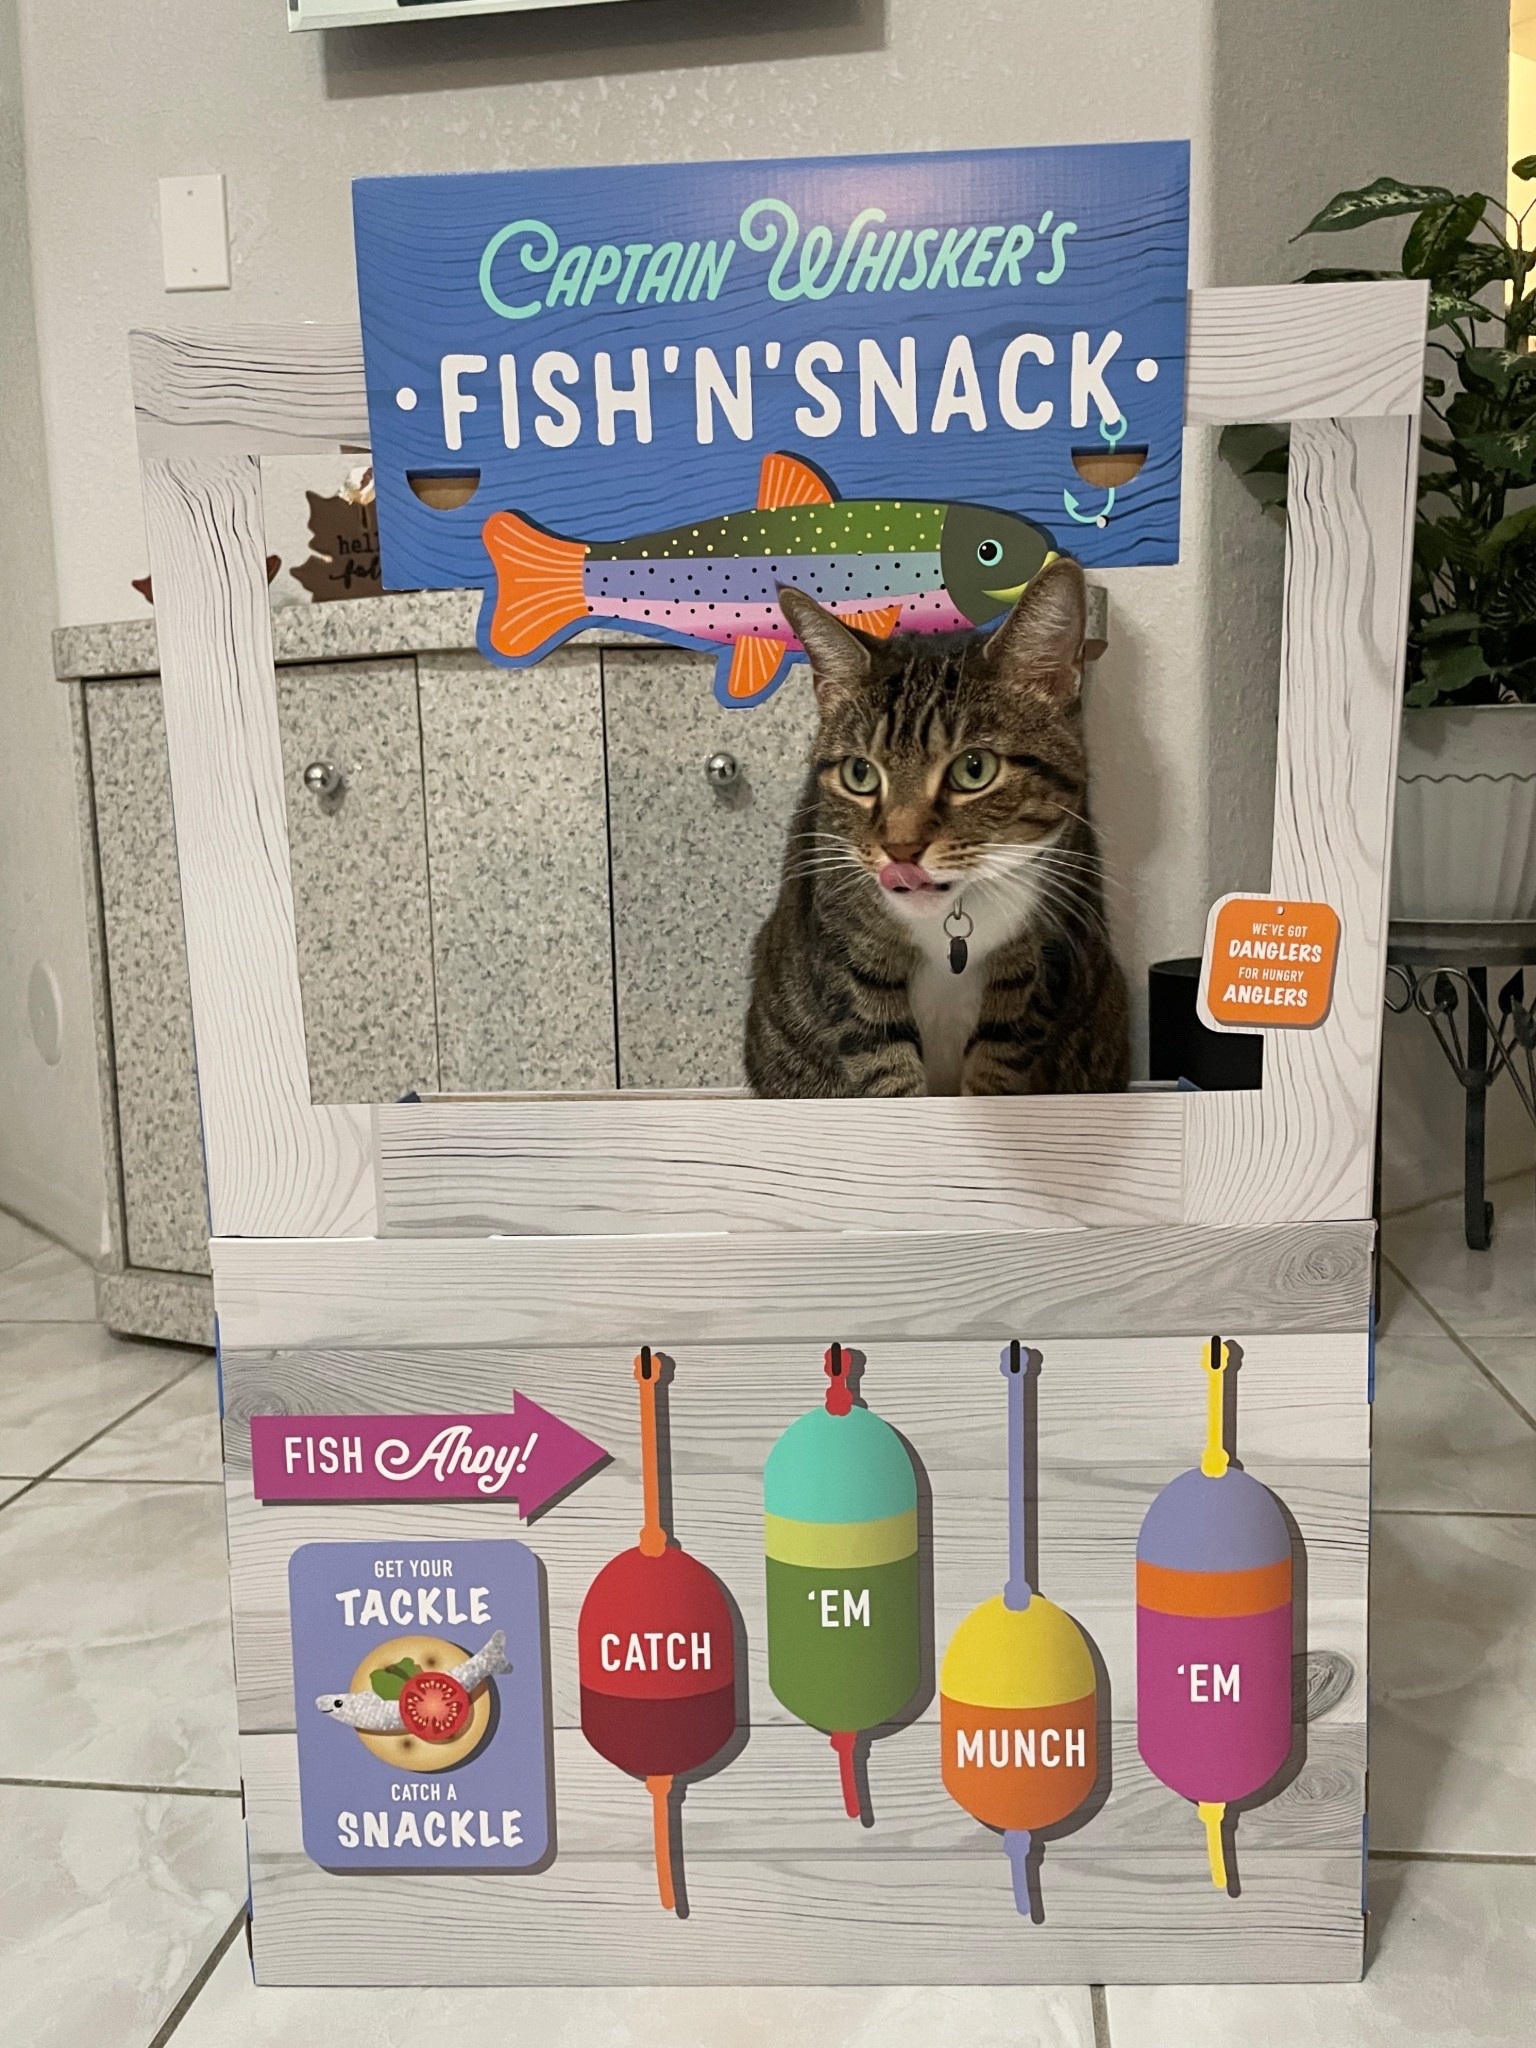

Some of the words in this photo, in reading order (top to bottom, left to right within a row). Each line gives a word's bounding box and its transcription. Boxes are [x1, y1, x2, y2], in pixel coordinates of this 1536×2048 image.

[479, 219, 735, 320] CAPTAIN
[740, 198, 1078, 302] WHISKER'S
[440, 330, 1124, 451] FISH'N'SNACK
[337, 532, 379, 555] hel
[1252, 922, 1285, 937] WE'VE
[1287, 925, 1308, 938] GOT
[1228, 939, 1322, 963] DANGLERS
[1238, 966, 1258, 980] FOR
[1262, 968, 1304, 983] HUNGRY
[1222, 984, 1308, 1007] ANGLERS
[285, 1436, 363, 1474] FISH
[375, 1425, 539, 1494] Ahoy!
[374, 1559, 404, 1579] GET
[409, 1559, 454, 1578] YOUR
[336, 1586, 492, 1627] TACKLE
[601, 1632, 712, 1671] CATCH
[957, 1728, 1086, 1768] MUNCH
[391, 1782, 441, 1802] CATCH
[447, 1783, 458, 1801] A
[338, 1809, 524, 1849] SNACKLE
